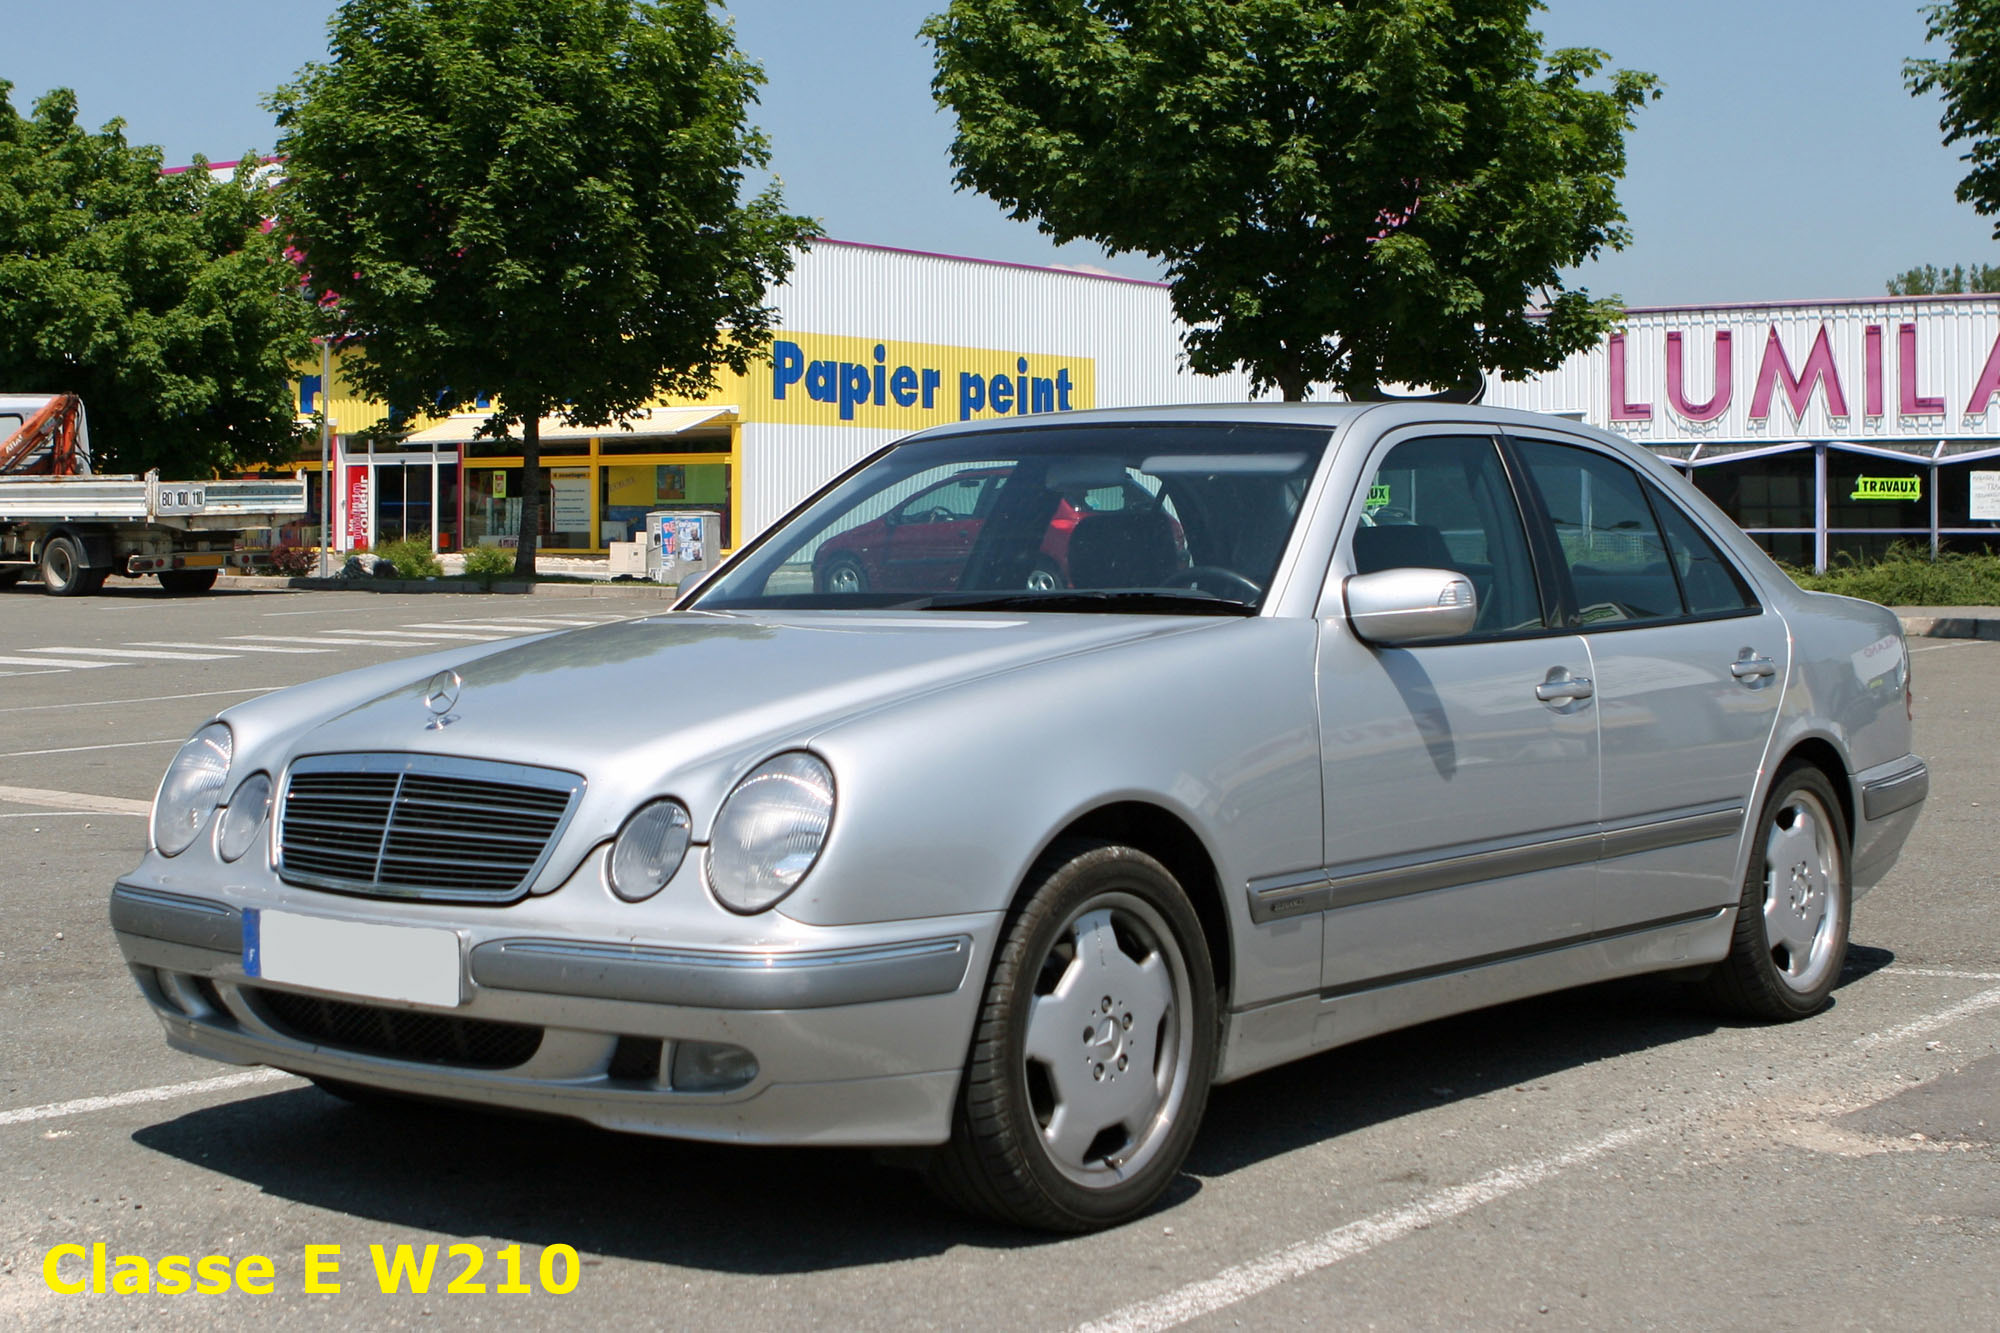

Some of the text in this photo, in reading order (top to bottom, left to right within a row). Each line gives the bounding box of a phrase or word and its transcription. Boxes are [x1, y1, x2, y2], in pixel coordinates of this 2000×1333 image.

[773, 340, 1073, 422] Papier peint
[162, 490, 203, 506] 80 100 110
[1862, 480, 1917, 492] TRAVAUX
[360, 475, 369, 537] couleur
